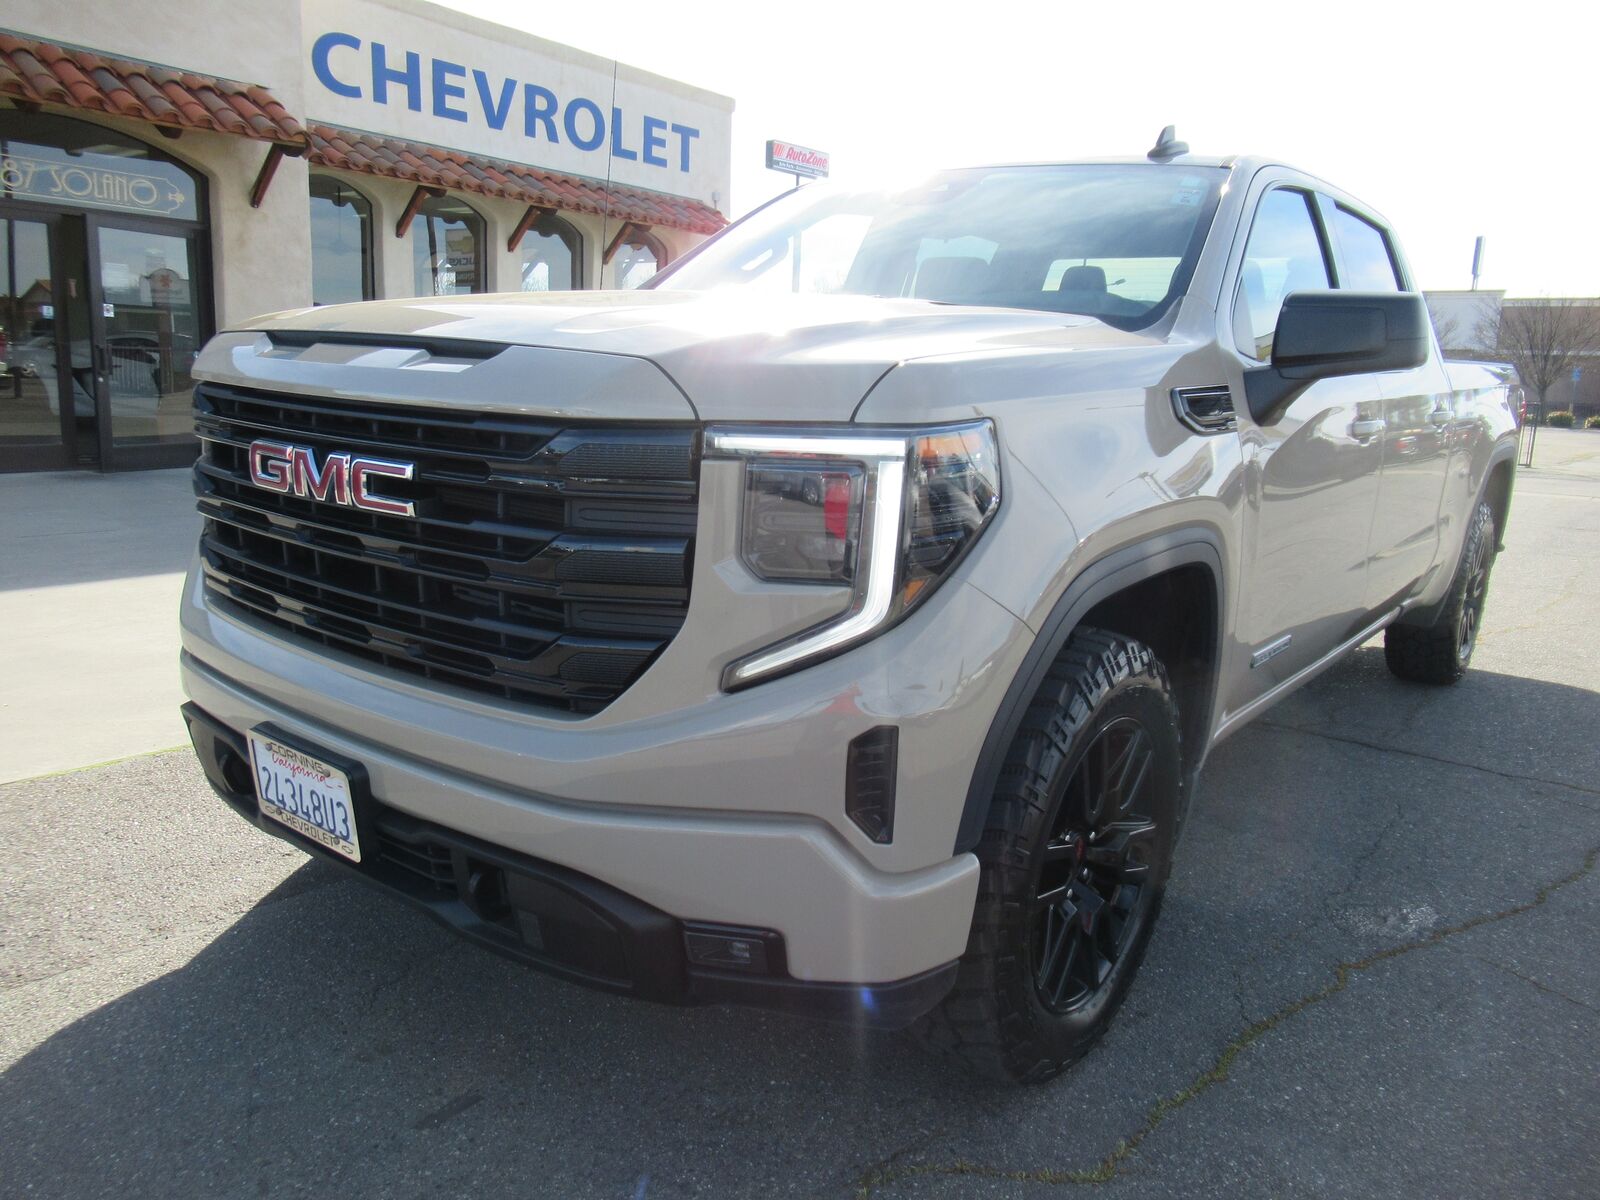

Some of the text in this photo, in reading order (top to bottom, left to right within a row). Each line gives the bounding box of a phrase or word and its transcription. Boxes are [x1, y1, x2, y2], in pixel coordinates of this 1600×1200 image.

[312, 32, 700, 173] CHEVROLET
[786, 147, 828, 168] AutoZone
[51, 165, 157, 204] SOLANO
[249, 438, 416, 517] GMC
[270, 742, 324, 773] CORNING
[262, 766, 350, 841] 24348U3
[281, 813, 336, 845] CHEVROLET
